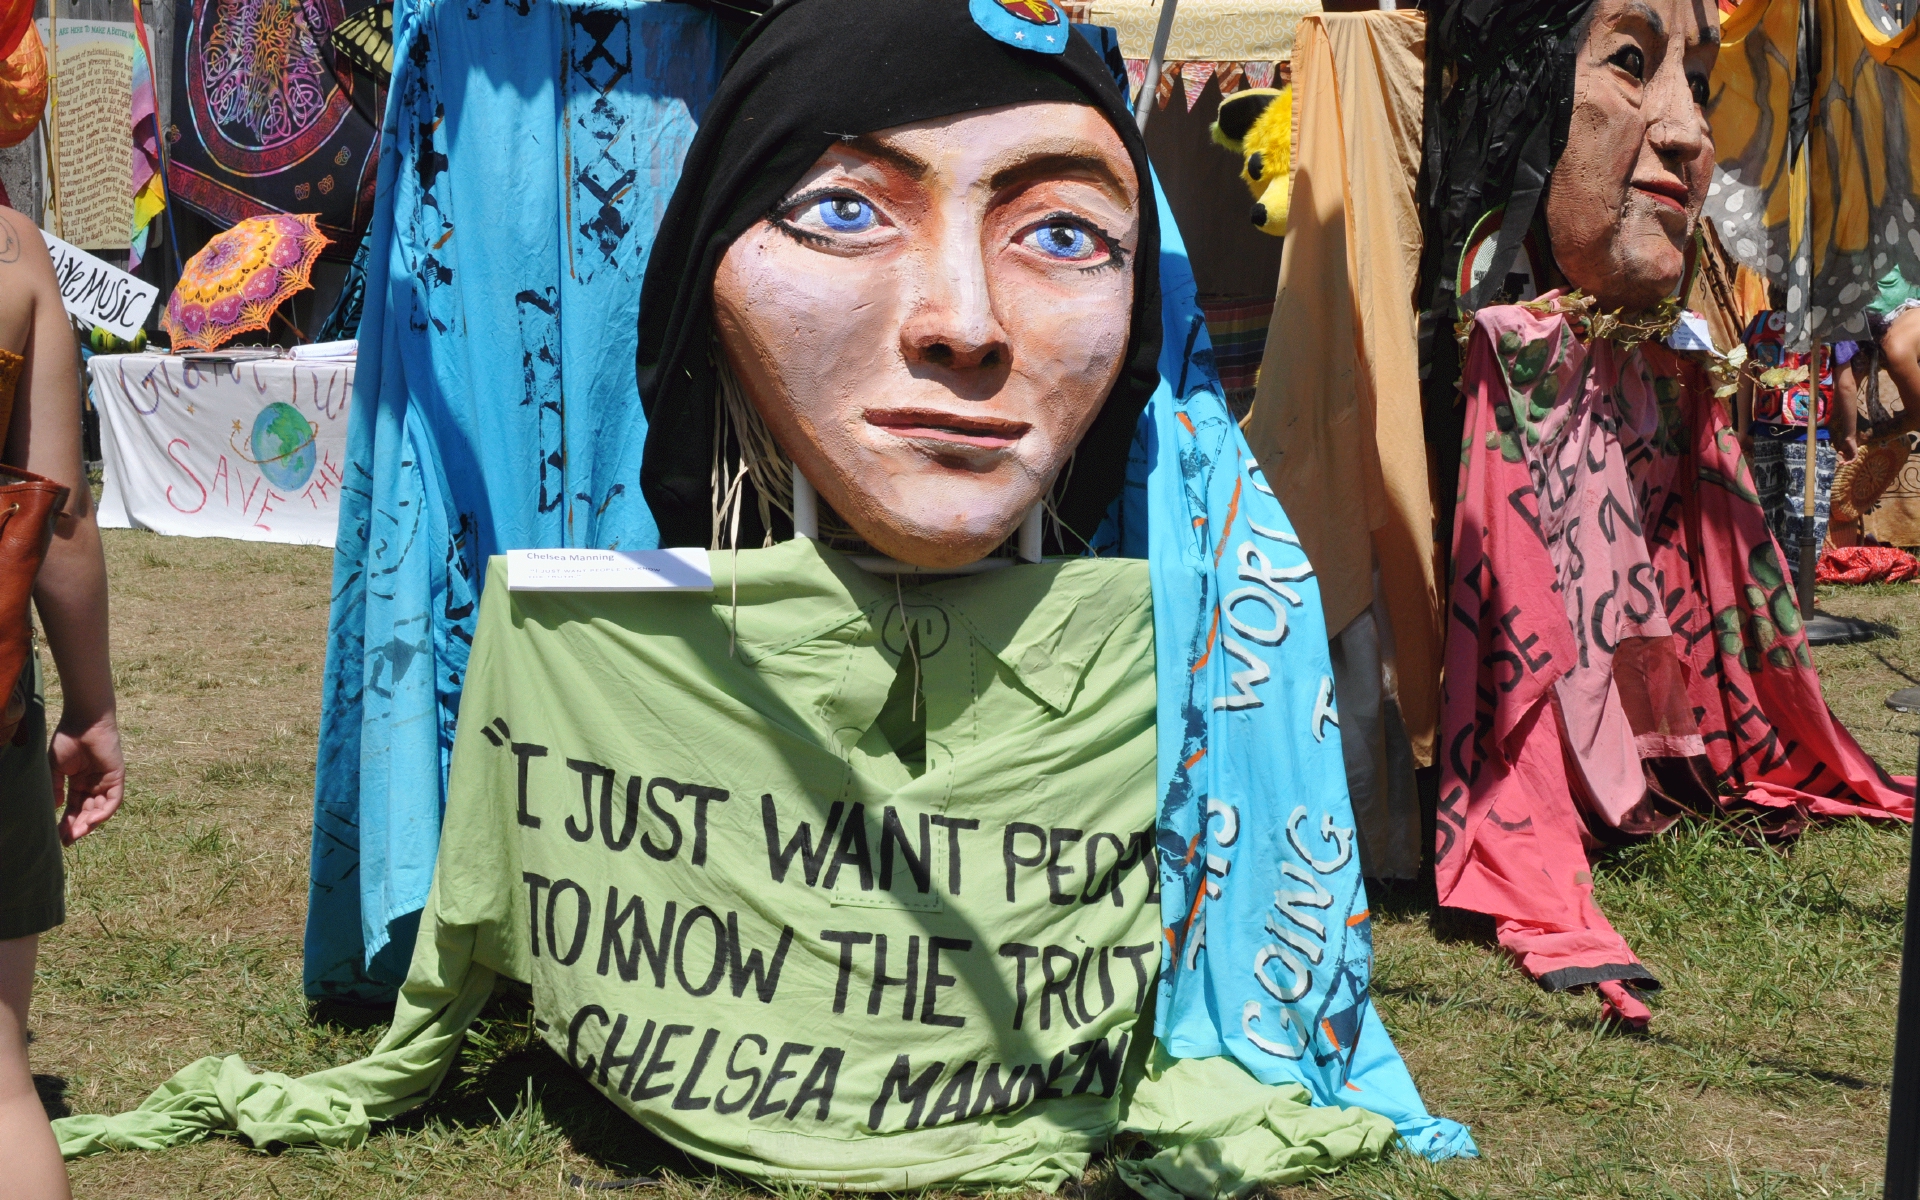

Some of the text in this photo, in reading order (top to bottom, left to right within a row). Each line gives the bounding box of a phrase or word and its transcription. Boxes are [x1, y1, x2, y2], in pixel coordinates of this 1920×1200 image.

[166, 437, 344, 532] SAVE THE
[527, 552, 615, 562] Chelsea Manning
[565, 756, 730, 867] JUST
[760, 792, 981, 896] WANT
[522, 871, 591, 968] TO
[596, 885, 794, 1004] KNOW
[819, 929, 973, 1028] THE
[1240, 804, 1354, 1060] GOING
